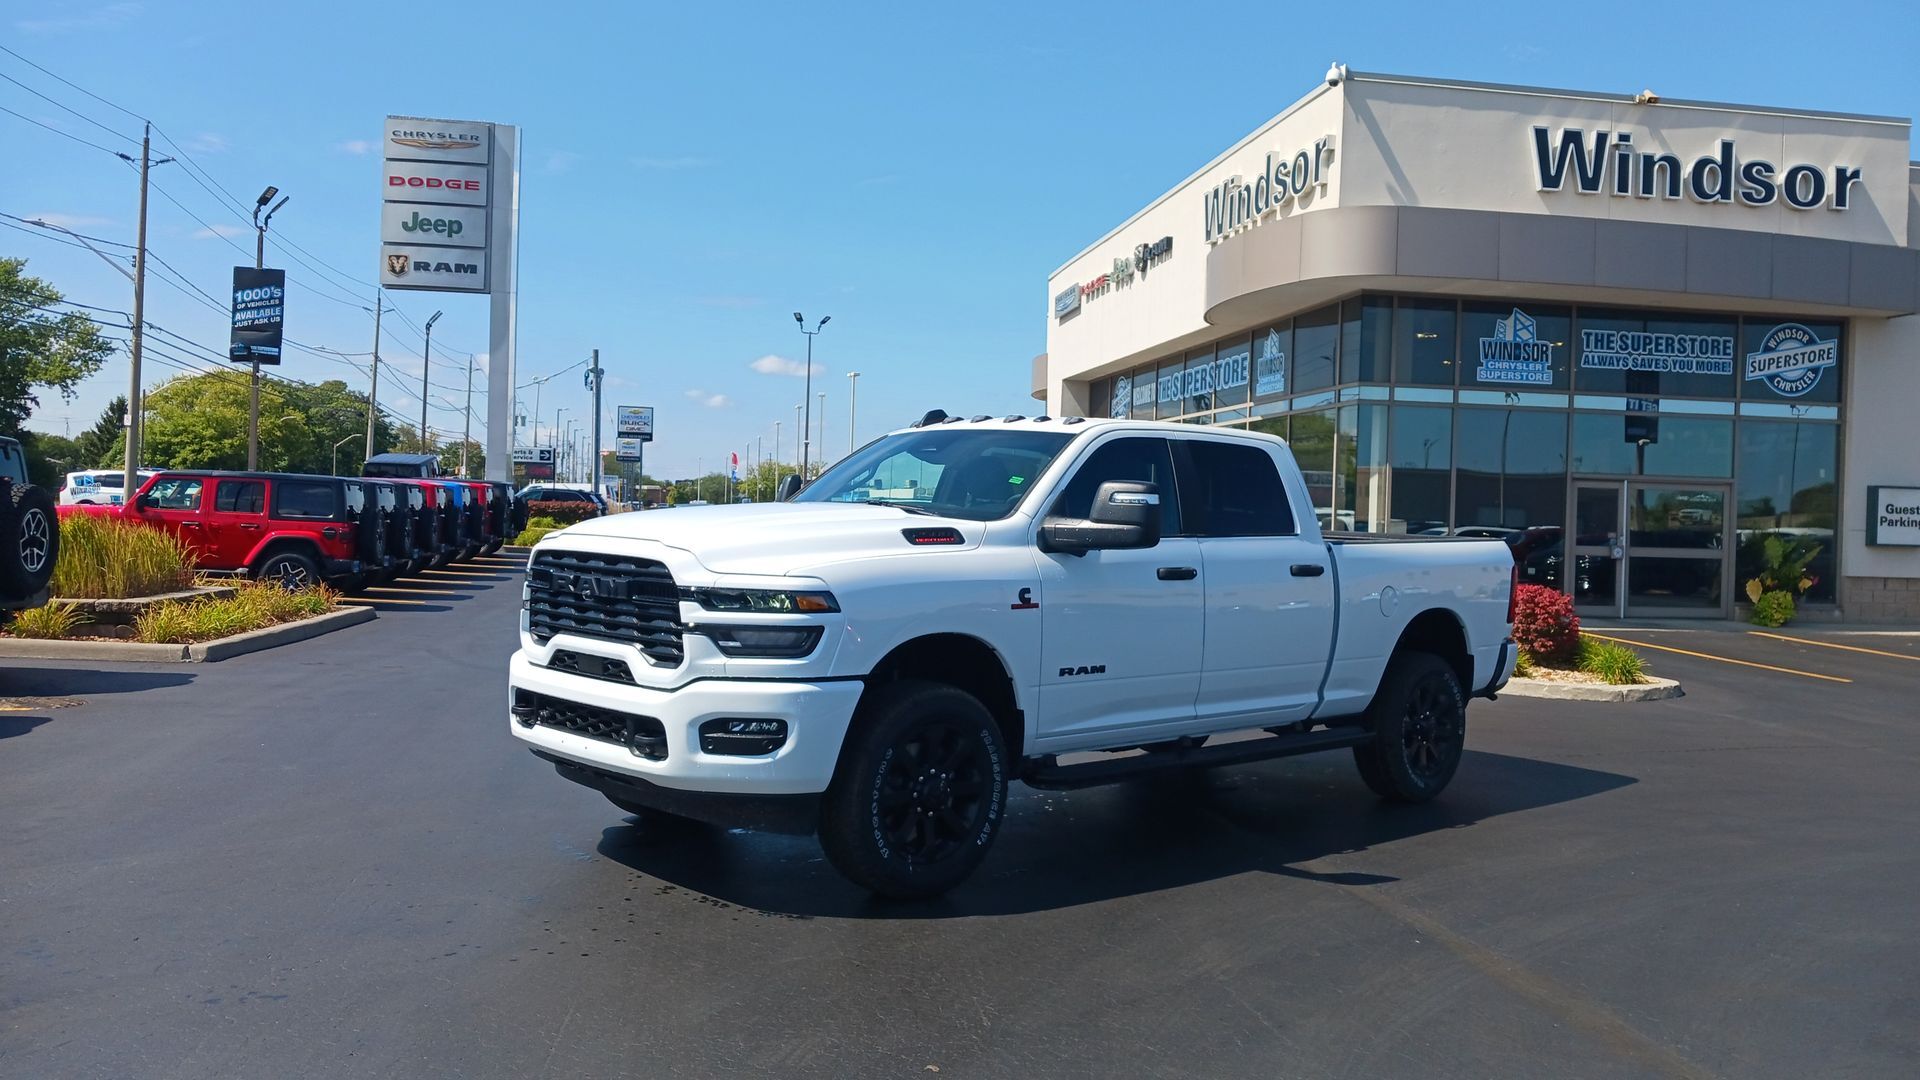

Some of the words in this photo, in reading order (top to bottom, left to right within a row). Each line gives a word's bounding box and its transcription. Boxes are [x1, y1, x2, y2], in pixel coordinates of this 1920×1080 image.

[392, 130, 480, 142] CHRYSLER
[1529, 125, 1862, 210] Windsor
[389, 176, 480, 190] DODGE
[1204, 135, 1334, 242] Windsor
[402, 212, 463, 238] Jeep
[413, 261, 478, 274] RAM
[247, 299, 280, 308] VEHICLES
[235, 308, 281, 320] AVAILABLE
[1583, 332, 1616, 352] THE
[1618, 332, 1732, 357] SUPERSTORE
[1768, 328, 1810, 348] WINDSOR
[1482, 341, 1550, 362] WINDSOR
[1750, 347, 1833, 374] SUPERSTORE
[1488, 362, 1542, 371] CHRYSLER
[1582, 354, 1629, 368] ALWAYS
[1632, 356, 1668, 370] SAVES
[1670, 358, 1693, 372] YOU
[1695, 360, 1732, 374] MORE!
[1159, 376, 1172, 402] THE
[1172, 352, 1249, 400] SUPERSTORE
[1480, 370, 1550, 382] SUPERSTORE
[1774, 370, 1816, 392] CHRYSLER
[1886, 504, 1920, 515] Guest
[553, 571, 630, 598] RAM
[1058, 665, 1106, 677] RAM
